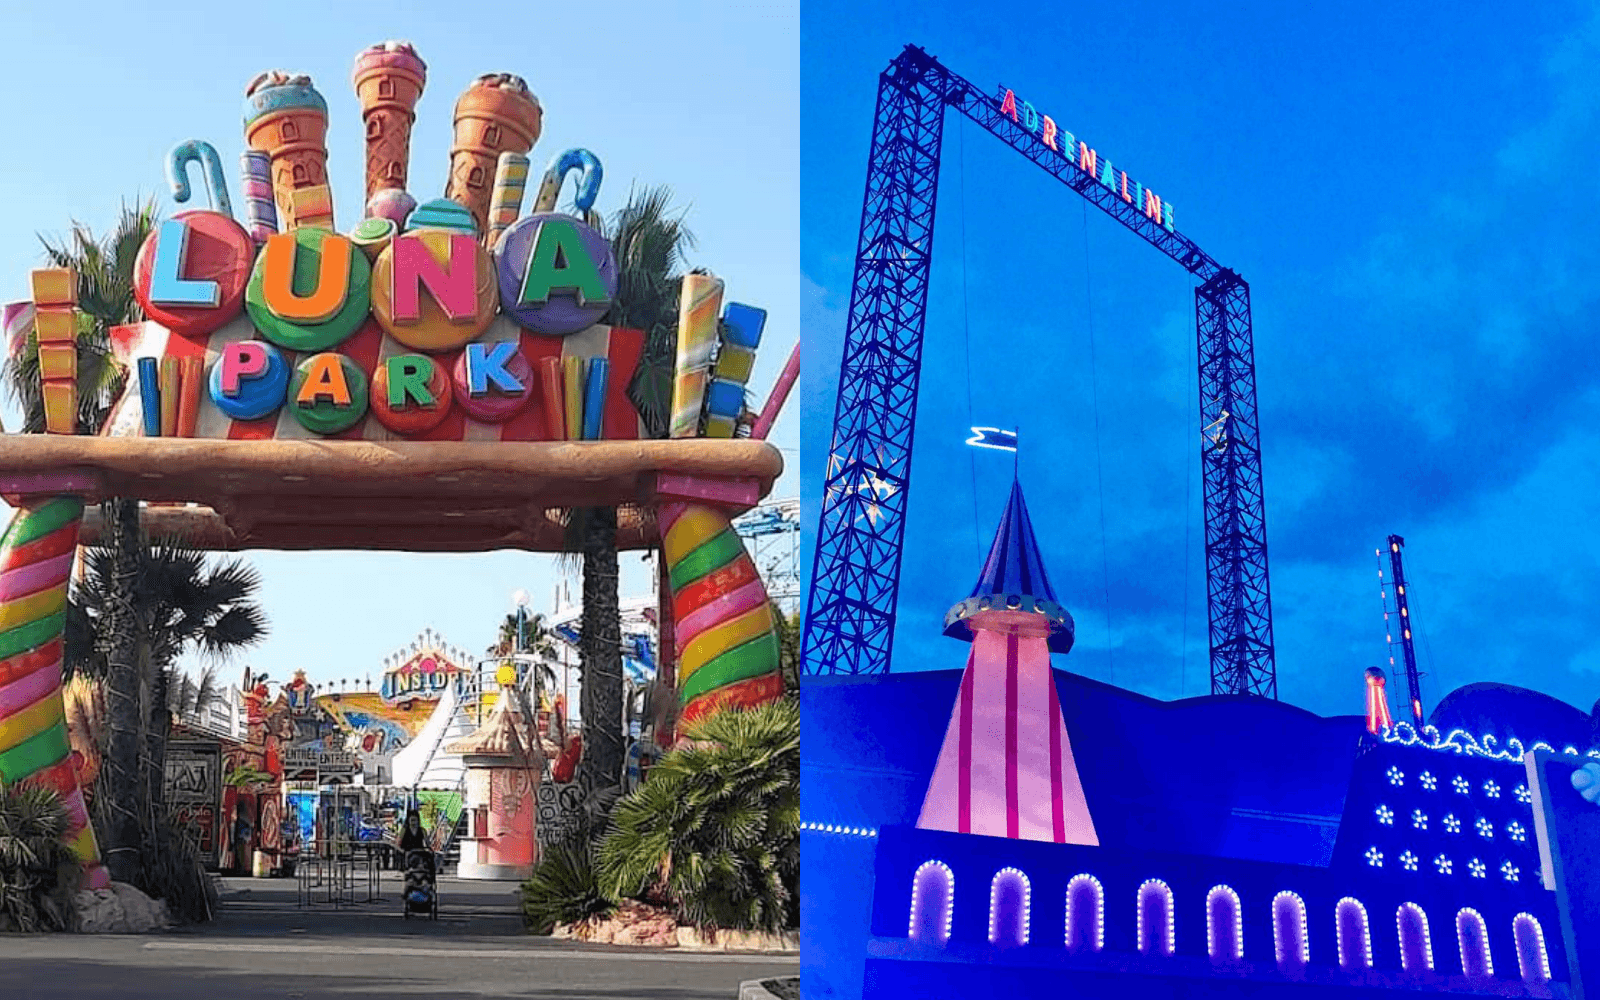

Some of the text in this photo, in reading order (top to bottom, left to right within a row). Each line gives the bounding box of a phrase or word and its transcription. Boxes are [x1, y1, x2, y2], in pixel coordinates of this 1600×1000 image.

[1000, 88, 1175, 234] ADRENALINE
[148, 217, 608, 324] LUNA
[219, 340, 527, 411] PARK
